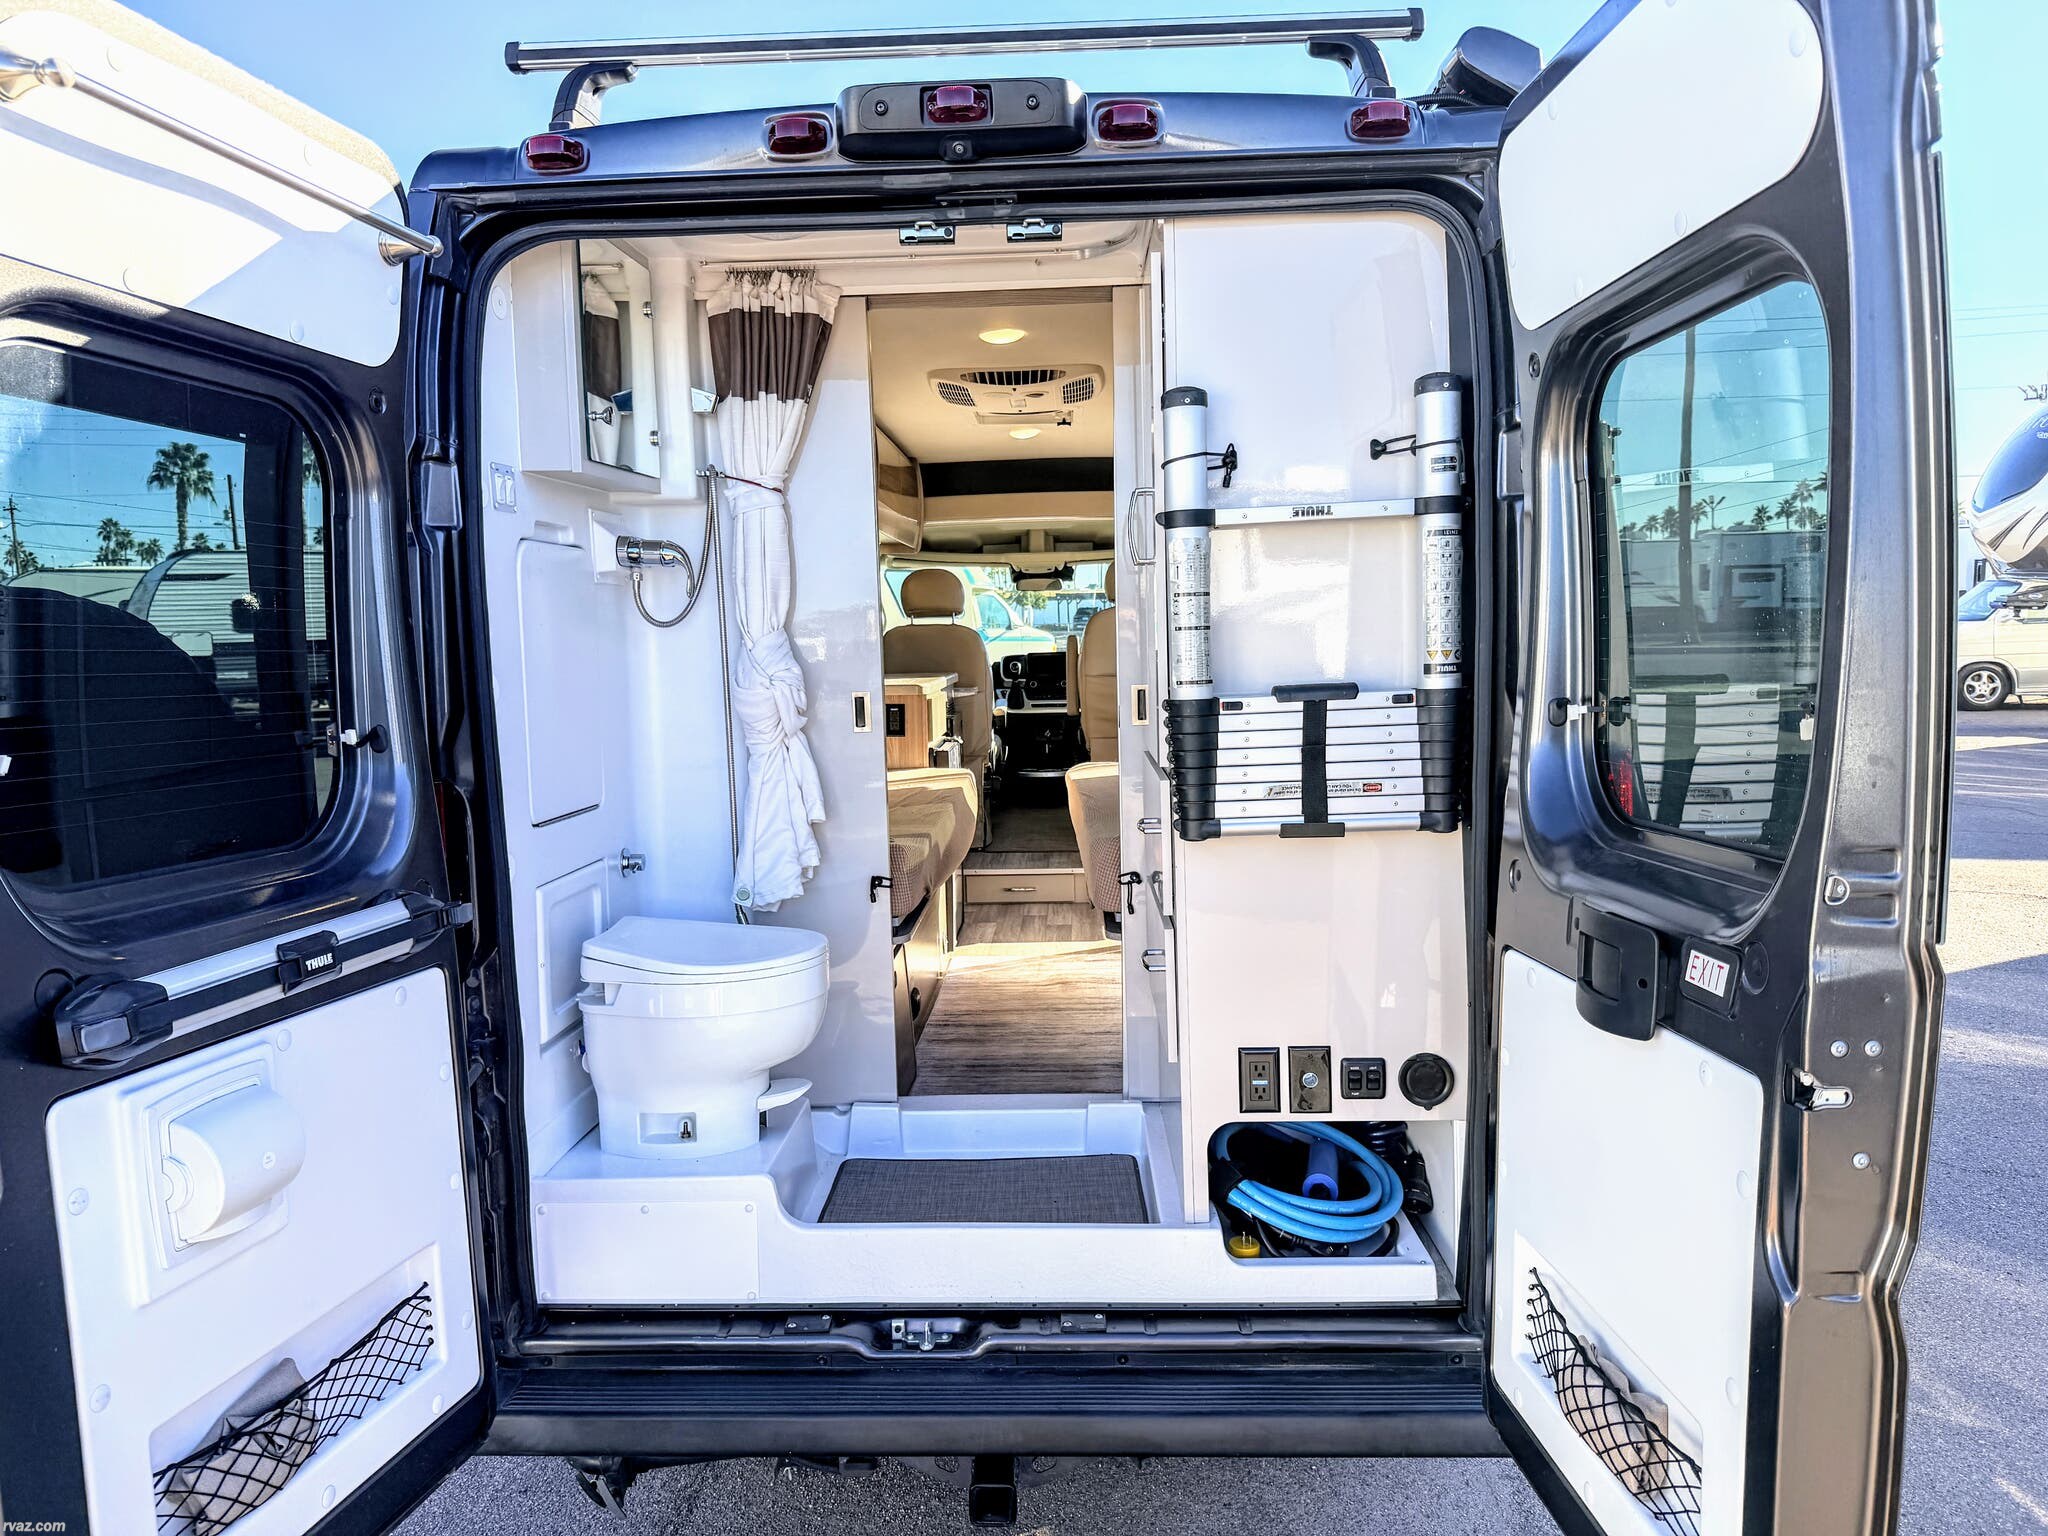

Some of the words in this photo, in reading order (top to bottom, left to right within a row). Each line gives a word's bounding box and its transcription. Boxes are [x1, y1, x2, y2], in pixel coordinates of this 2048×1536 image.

[1292, 505, 1333, 517] THULE
[305, 953, 333, 971] THULE
[1689, 955, 1725, 991] EXIT
